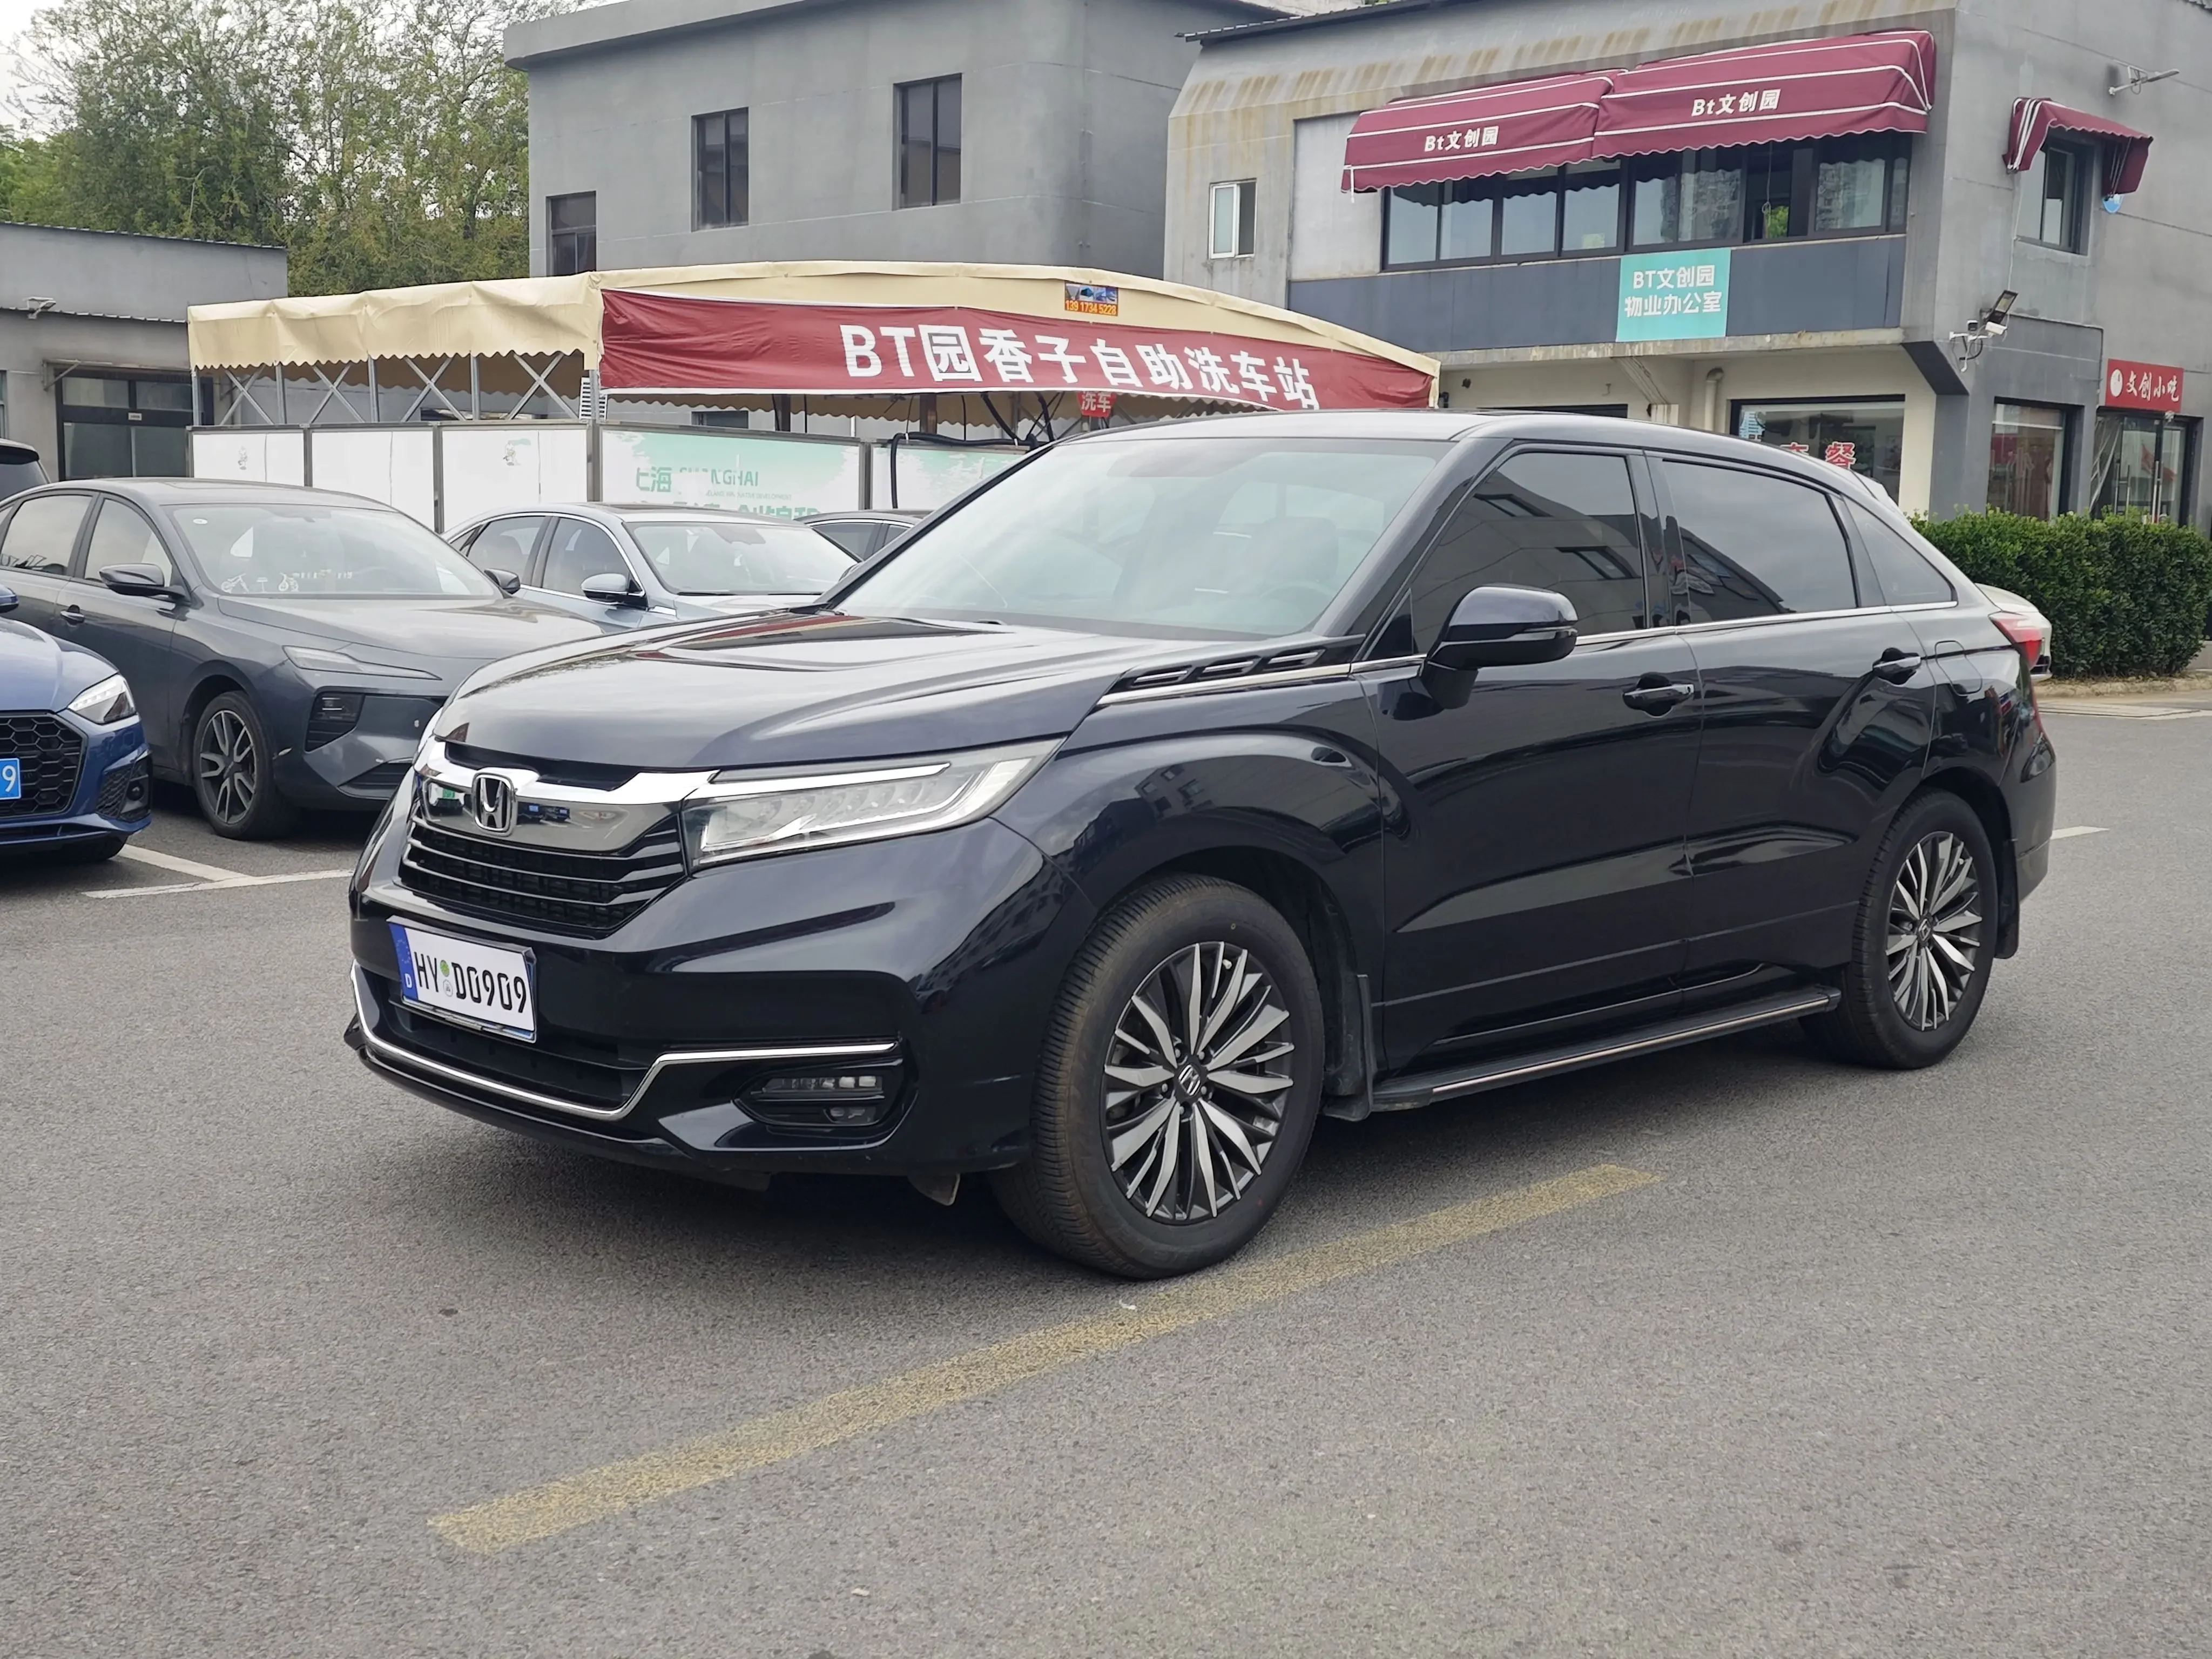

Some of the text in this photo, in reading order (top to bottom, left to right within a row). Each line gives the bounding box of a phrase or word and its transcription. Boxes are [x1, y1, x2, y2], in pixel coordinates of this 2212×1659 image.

[1691, 89, 1781, 117] Bt文创园
[1424, 125, 1499, 152] Bt文创园
[1633, 264, 1715, 290] BT文创园
[1065, 300, 1078, 311] 139
[1080, 301, 1098, 313] 1734
[1624, 291, 1722, 318] 物业办公室
[839, 324, 1320, 410] BT园香子自助洗车站
[1081, 391, 1111, 413] 洗车
[2, 765, 16, 792] 9
